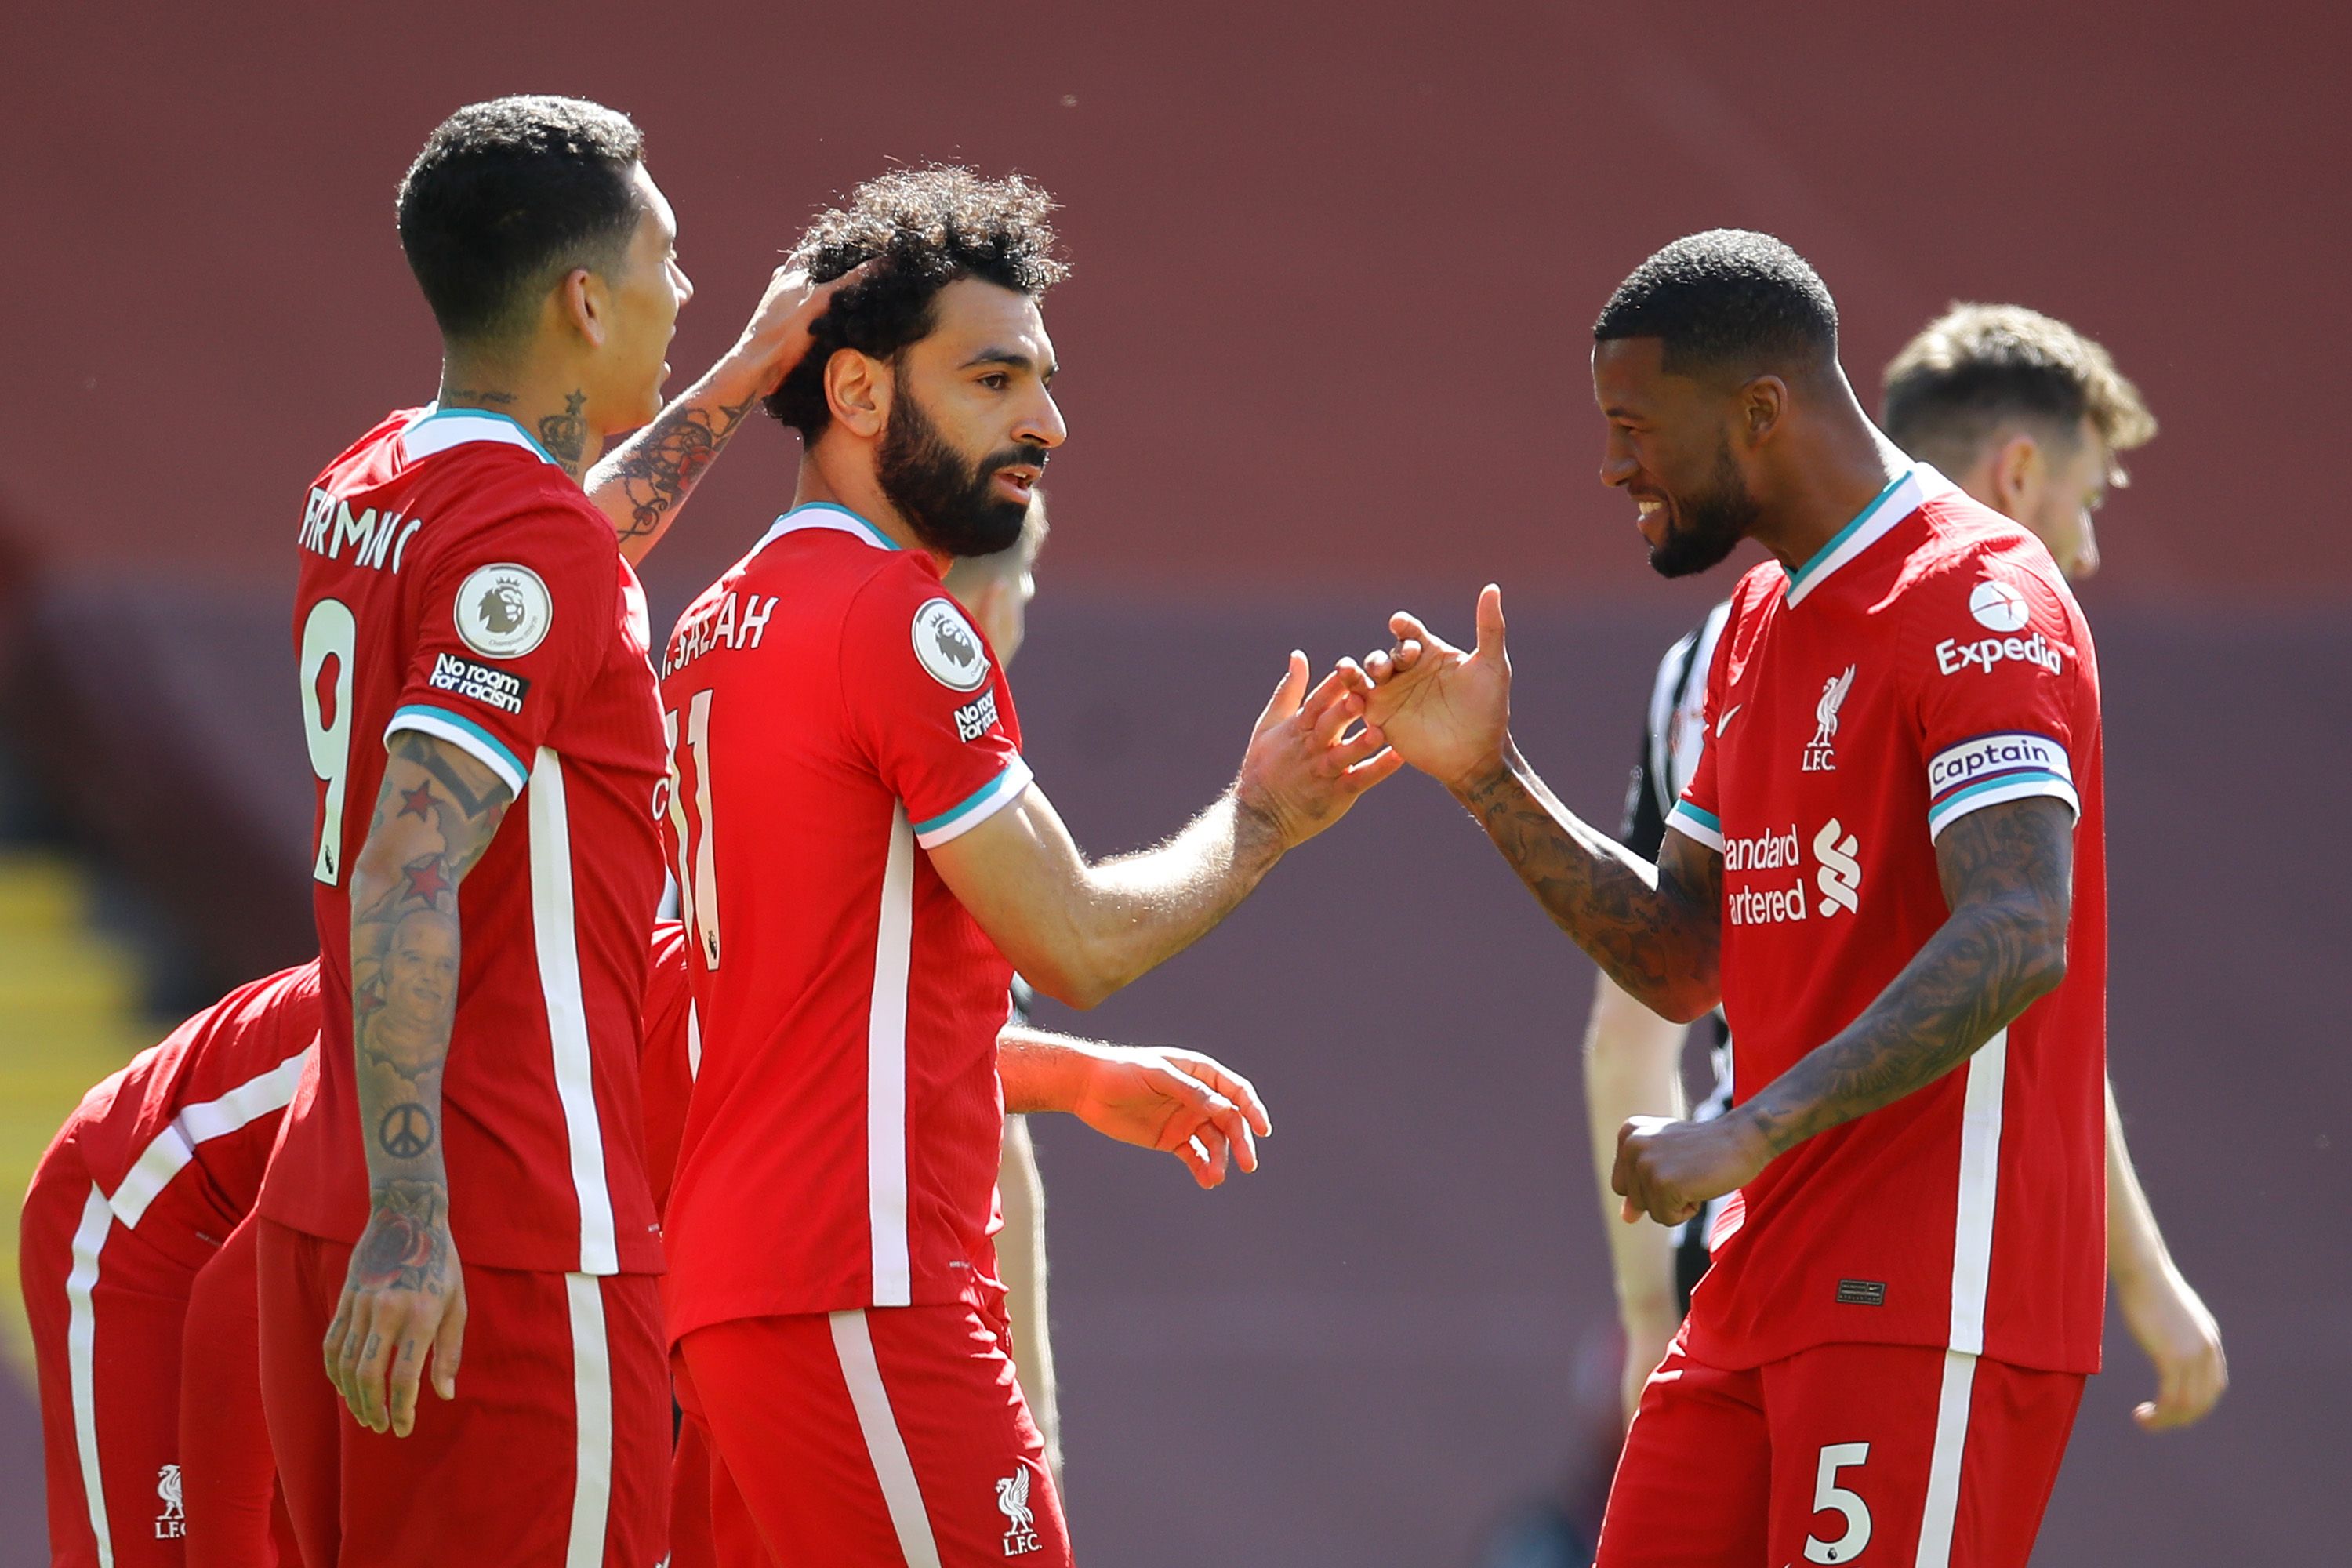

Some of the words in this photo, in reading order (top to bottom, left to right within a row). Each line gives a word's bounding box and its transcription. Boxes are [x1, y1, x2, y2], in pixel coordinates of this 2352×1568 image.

[435, 652, 465, 676] No
[466, 665, 520, 695] room
[1936, 632, 2062, 676] Expedia
[429, 669, 460, 690] for
[458, 680, 522, 714] racism
[954, 706, 978, 726] No
[959, 720, 982, 744] for
[300, 598, 356, 887] 9
[1933, 739, 2050, 785] Captain
[665, 688, 720, 971] 11
[1722, 823, 1799, 870] andard
[1729, 878, 1806, 925] artered
[1803, 1442, 1872, 1565] 5
